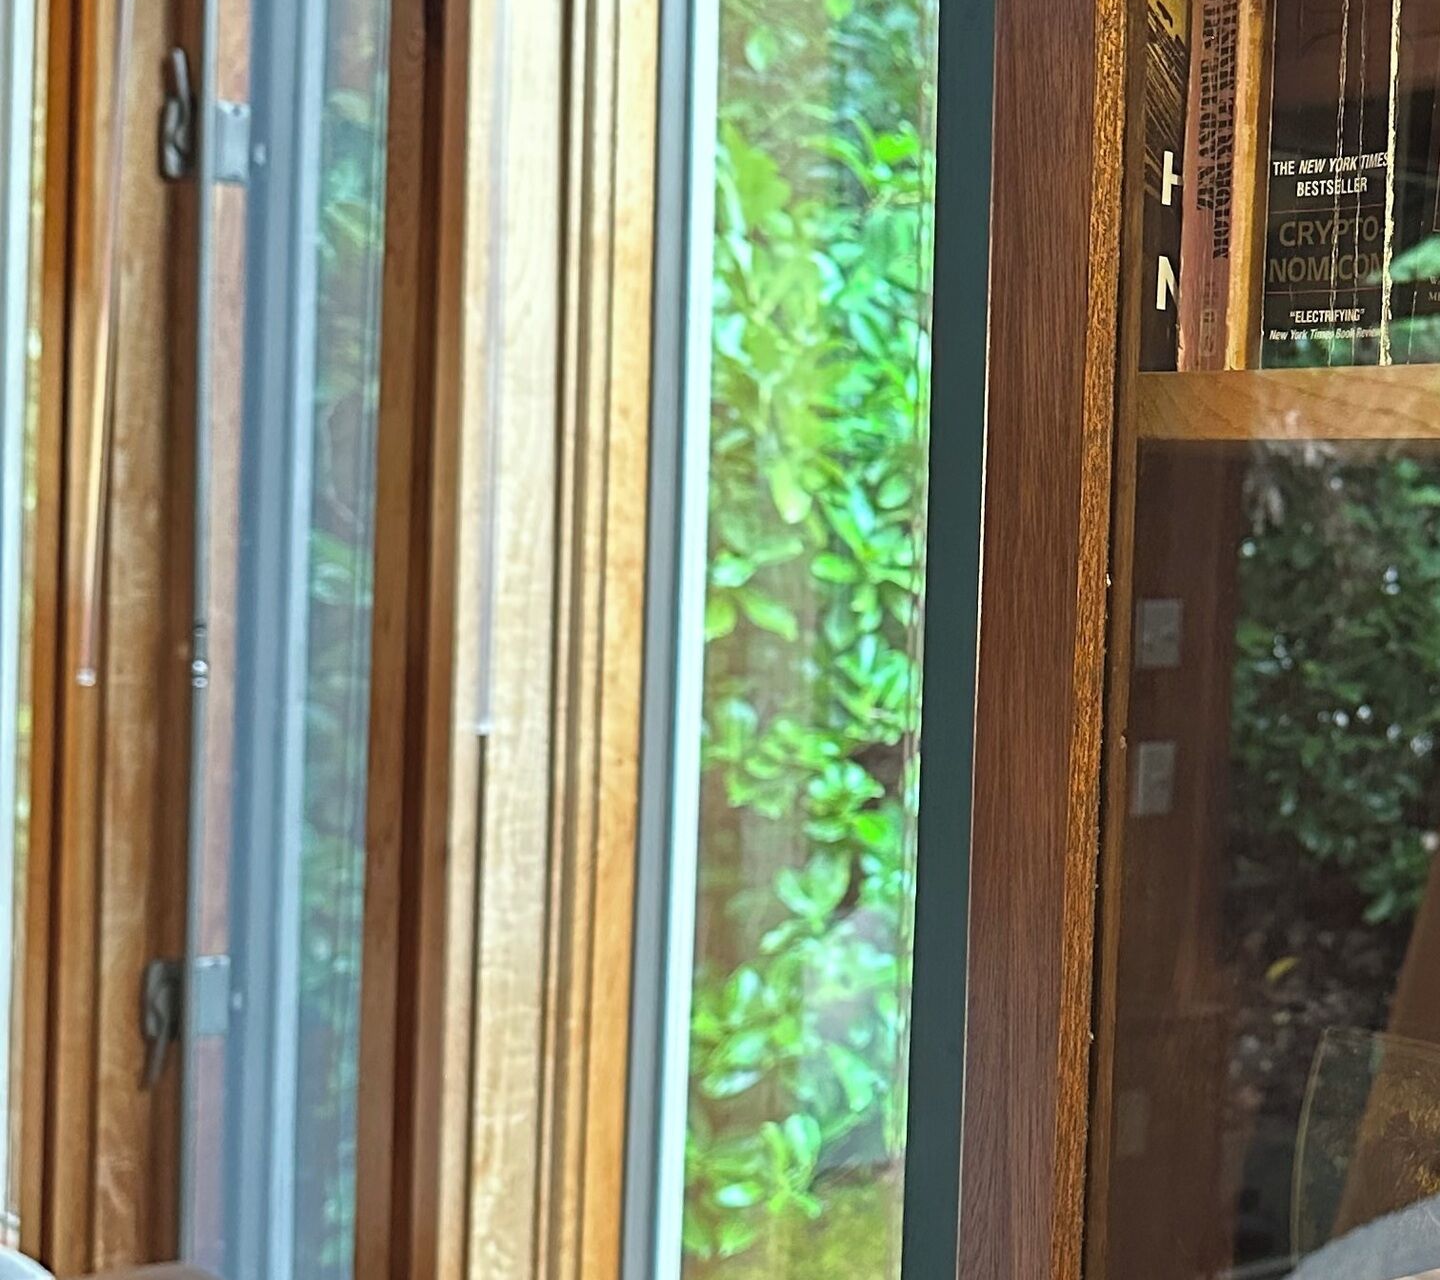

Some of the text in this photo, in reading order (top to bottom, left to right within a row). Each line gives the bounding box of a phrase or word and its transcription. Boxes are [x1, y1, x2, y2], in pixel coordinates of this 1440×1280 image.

[1273, 152, 1389, 176] THE NEW YORK TIMES
[1297, 177, 1368, 197] BESTSELLER
[1279, 216, 1384, 248] CRYPTO-
[1269, 250, 1383, 283] NOMICON
[1269, 327, 1381, 340] New York Times Book Review
